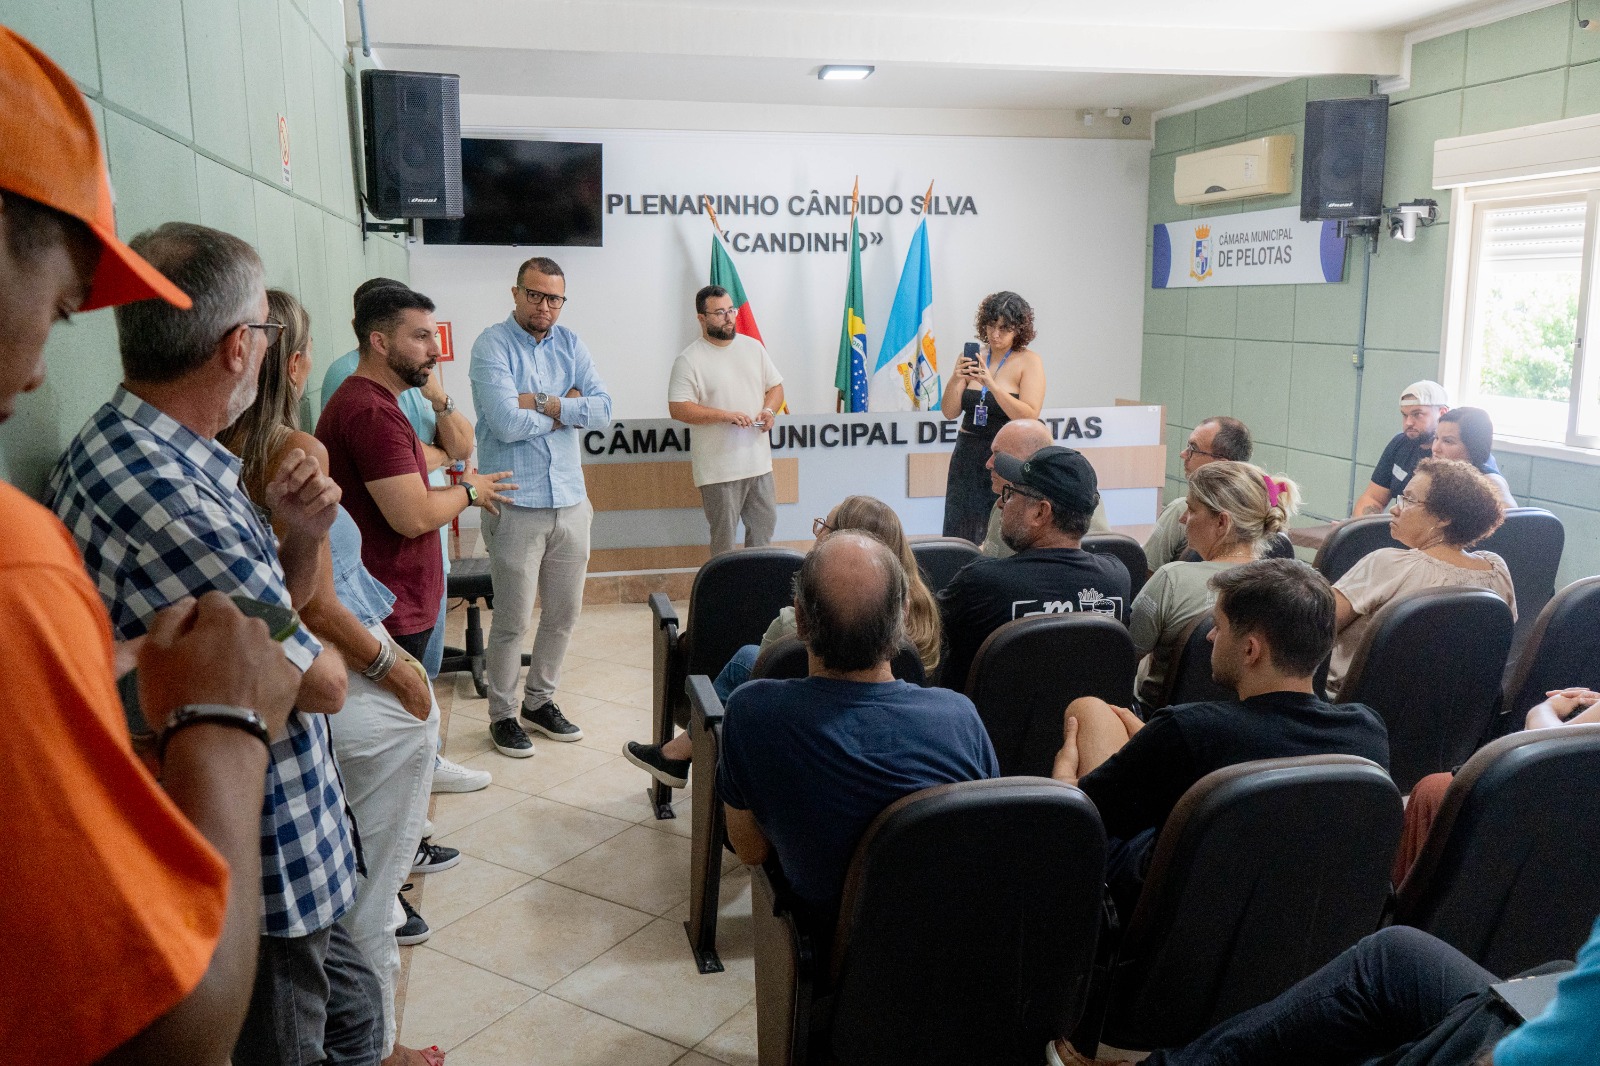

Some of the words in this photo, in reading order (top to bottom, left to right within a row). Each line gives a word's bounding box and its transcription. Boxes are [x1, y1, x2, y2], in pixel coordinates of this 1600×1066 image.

[607, 194, 779, 216] PLENARINHO
[788, 189, 903, 216] CÂNDIDO
[910, 195, 978, 216] SILVA
[1219, 231, 1249, 246] CÂMARA
[1250, 228, 1293, 243] MUNICIPAL
[1218, 249, 1232, 268] DE
[1236, 245, 1292, 266] PELOTAS
[584, 423, 691, 455] CÂMA
[771, 421, 908, 450] UNICIPAL
[918, 420, 958, 445] DE
